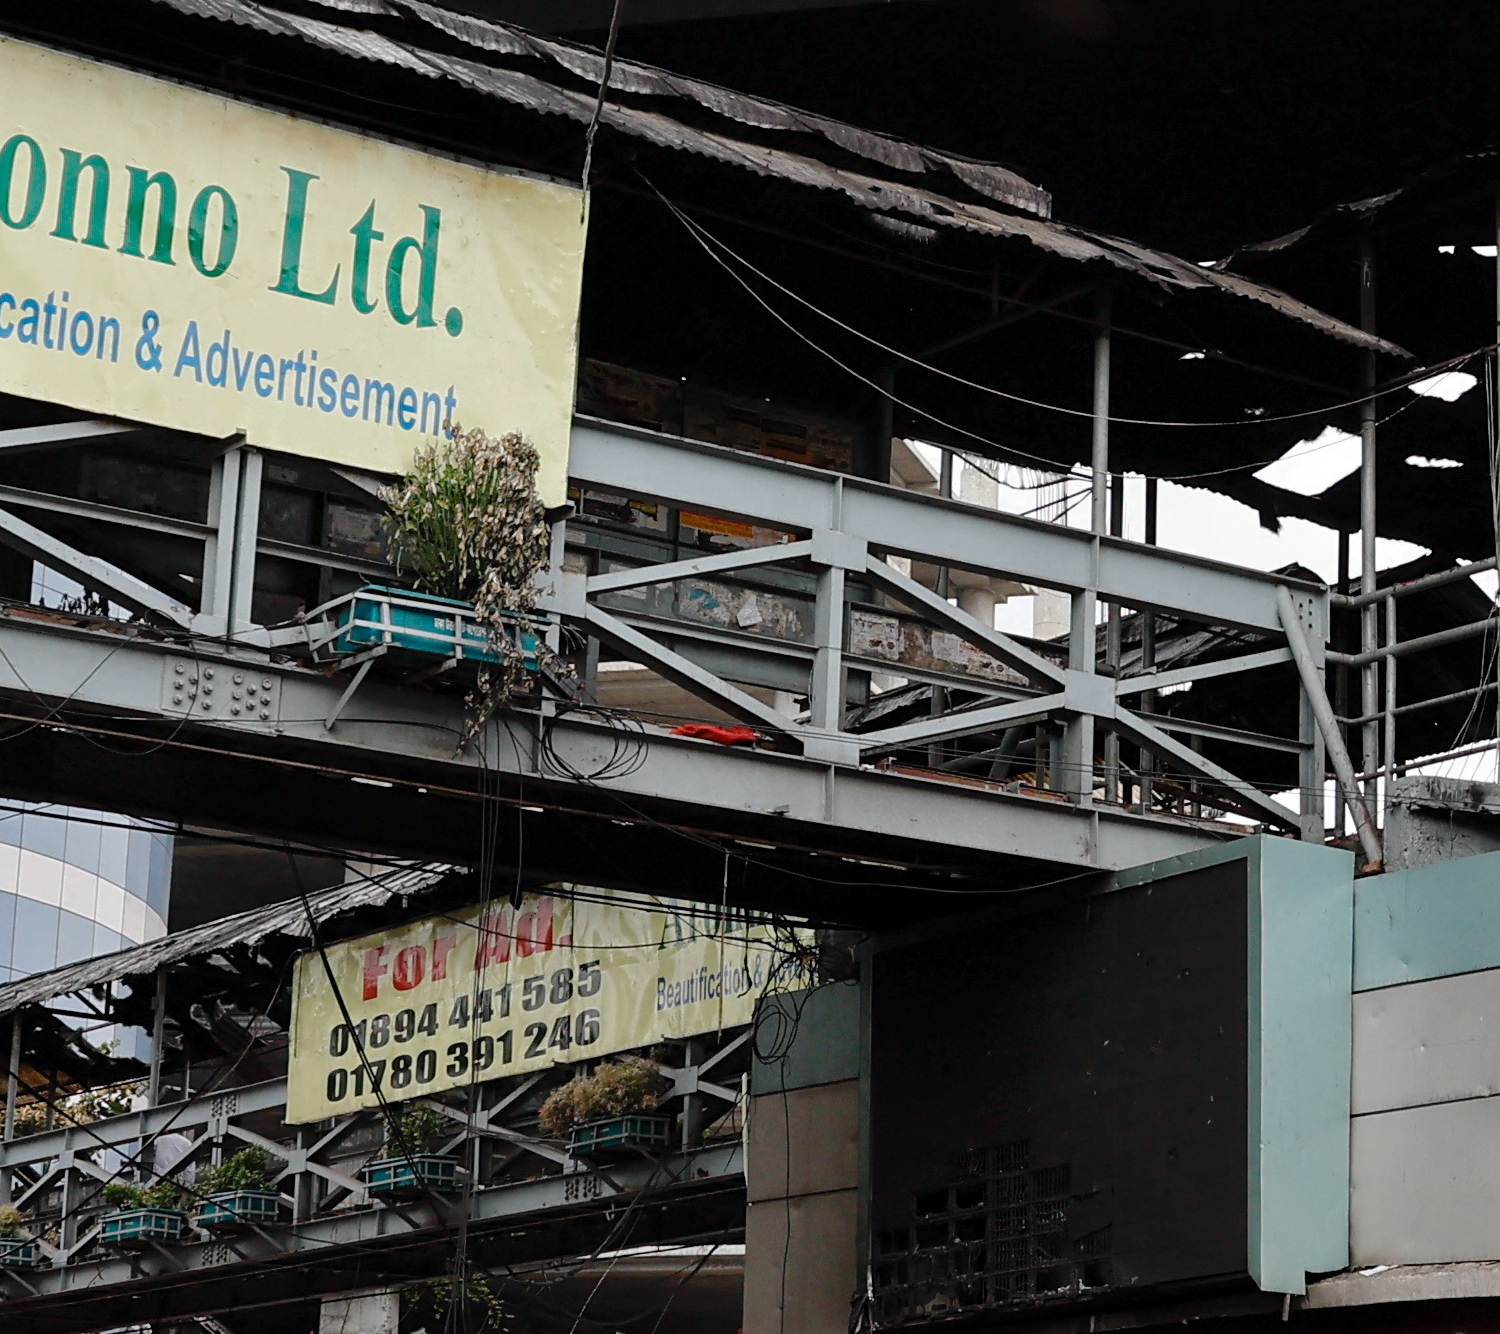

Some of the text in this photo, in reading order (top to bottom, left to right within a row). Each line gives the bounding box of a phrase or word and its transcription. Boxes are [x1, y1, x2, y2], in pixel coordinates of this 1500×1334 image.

[268, 165, 464, 339] Ltd.
[134, 308, 164, 372] &
[174, 320, 459, 442] Advertisement
[362, 897, 573, 1003] For Ad.
[656, 953, 749, 1012] Beautification
[326, 1009, 601, 1102] 01780 391 246
[331, 959, 601, 1058] 01894 441 585
